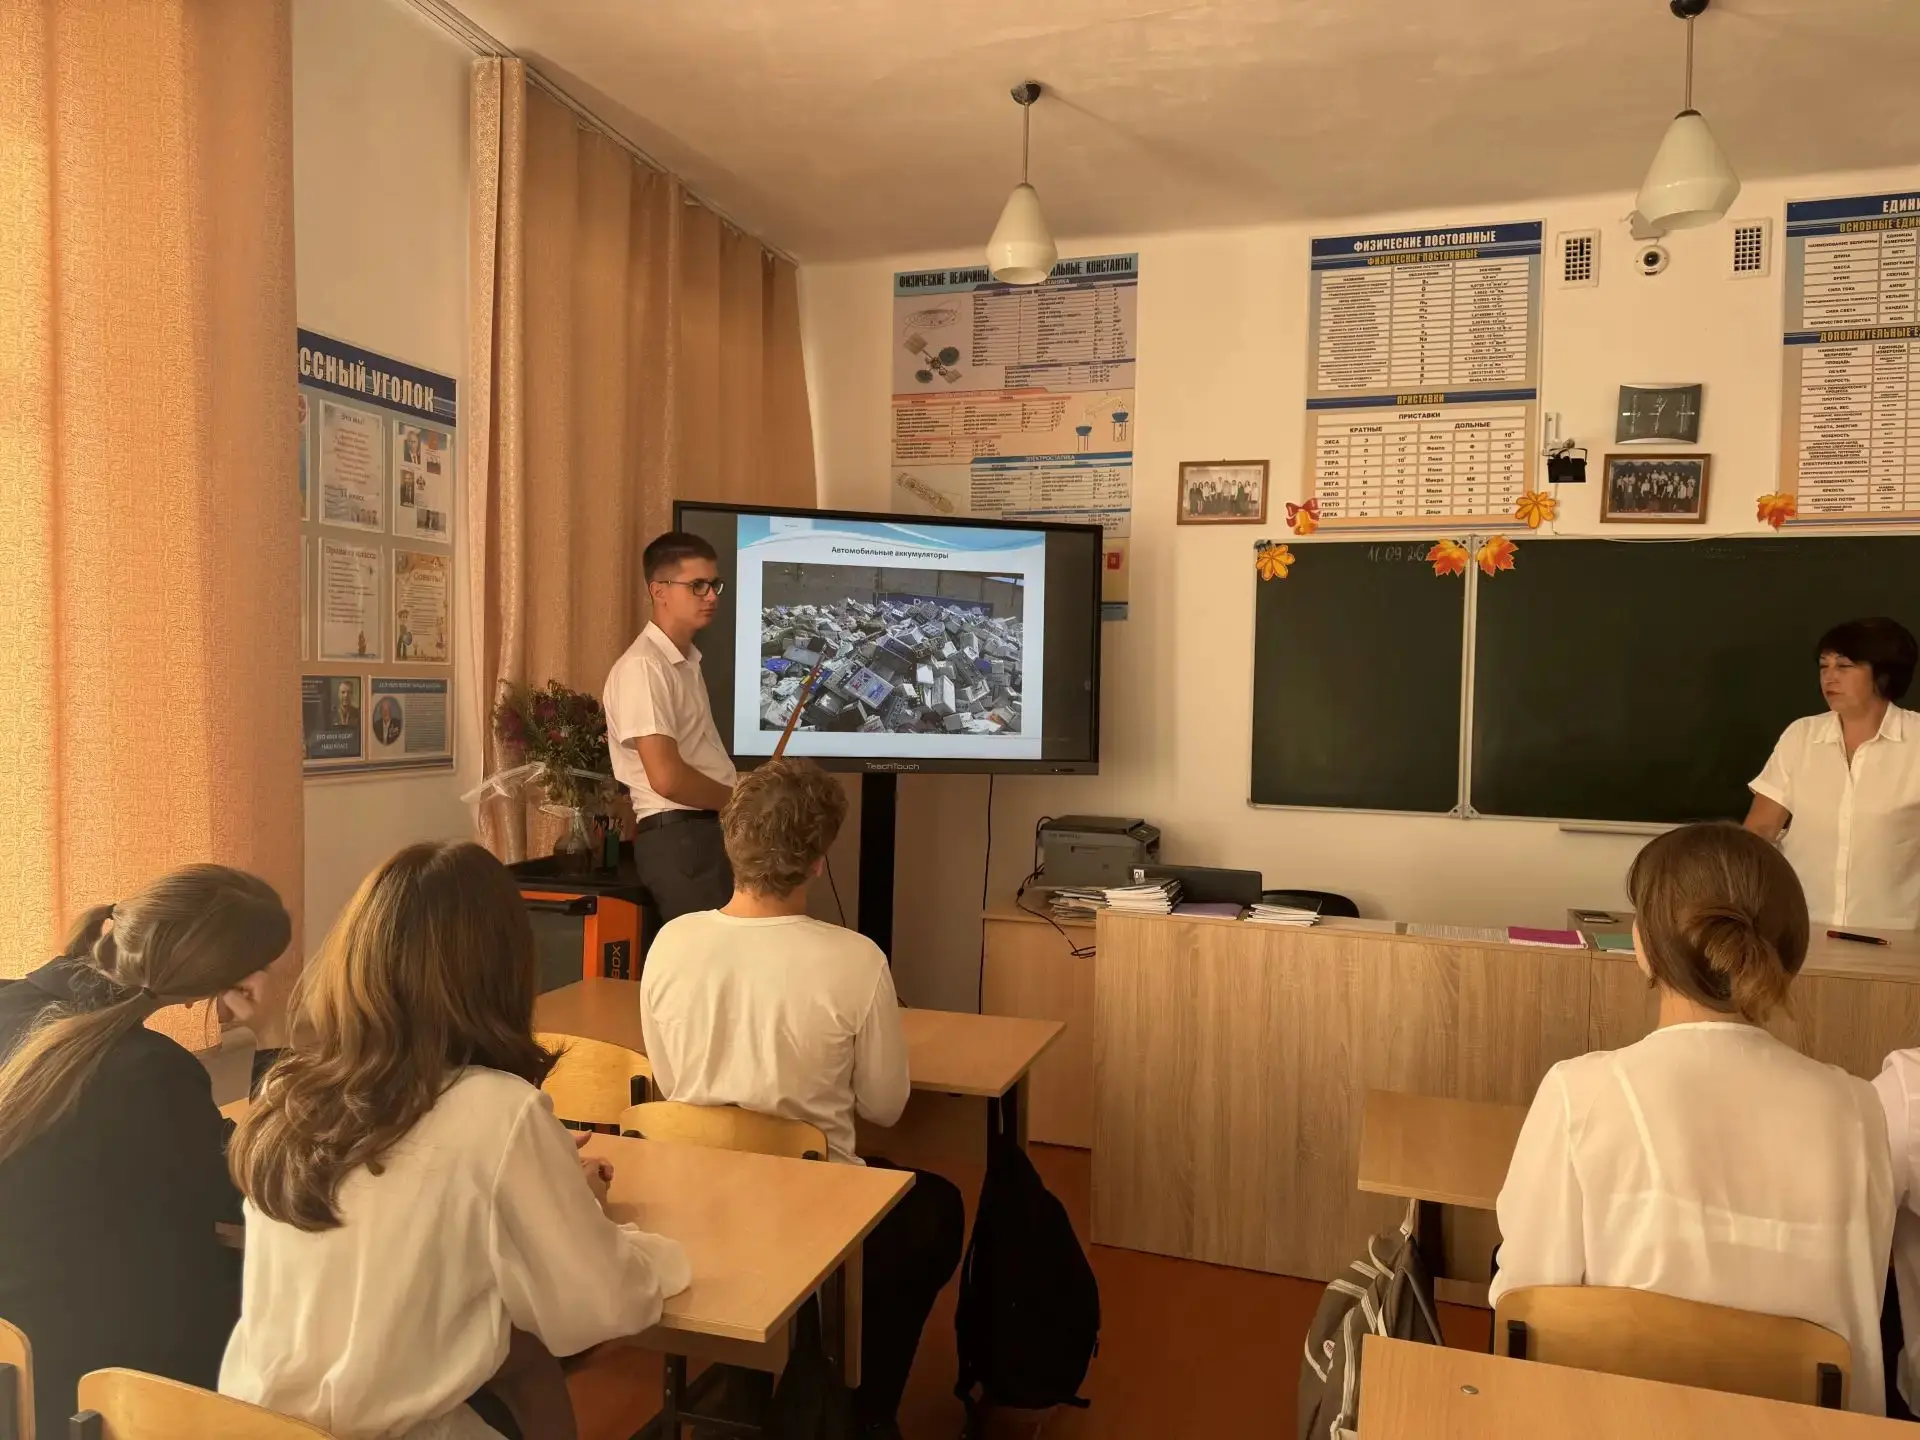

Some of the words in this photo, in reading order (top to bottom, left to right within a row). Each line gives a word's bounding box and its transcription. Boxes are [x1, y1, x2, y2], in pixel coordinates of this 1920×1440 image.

[1840, 219, 1893, 233] ОСНОВНЫЕ
[1354, 236, 1422, 252] ФИЗИЧЕСКИЕ
[1425, 230, 1496, 247] ПОСТОЯННЫЕ
[1368, 253, 1421, 266] ФИЗИЧЕСКИЕ
[1423, 249, 1479, 263] ПОСТОЯННЫЕ
[899, 272, 946, 288] ФИЗИЧЕСКИЕ
[950, 268, 989, 285] ВЕЛИЧИНЫ
[1086, 257, 1132, 274] КОНСТАНТЫ
[1820, 327, 1911, 343] ДОПОЛНИТЕЛЬНЫЕ
[300, 347, 366, 393] ССНЫЙ
[372, 369, 434, 412] УГОЛОК
[1397, 394, 1444, 405] ПРИСТАВКИ
[1398, 412, 1441, 420] ПРИСТАВКИ
[1349, 425, 1383, 433] КРАТНЫЕ
[1454, 421, 1490, 429] ДОЛЬНЫЕ
[831, 546, 894, 557] Автомобильные
[895, 551, 949, 560] аккумуляторы
[866, 762, 920, 770] TeachTouch
